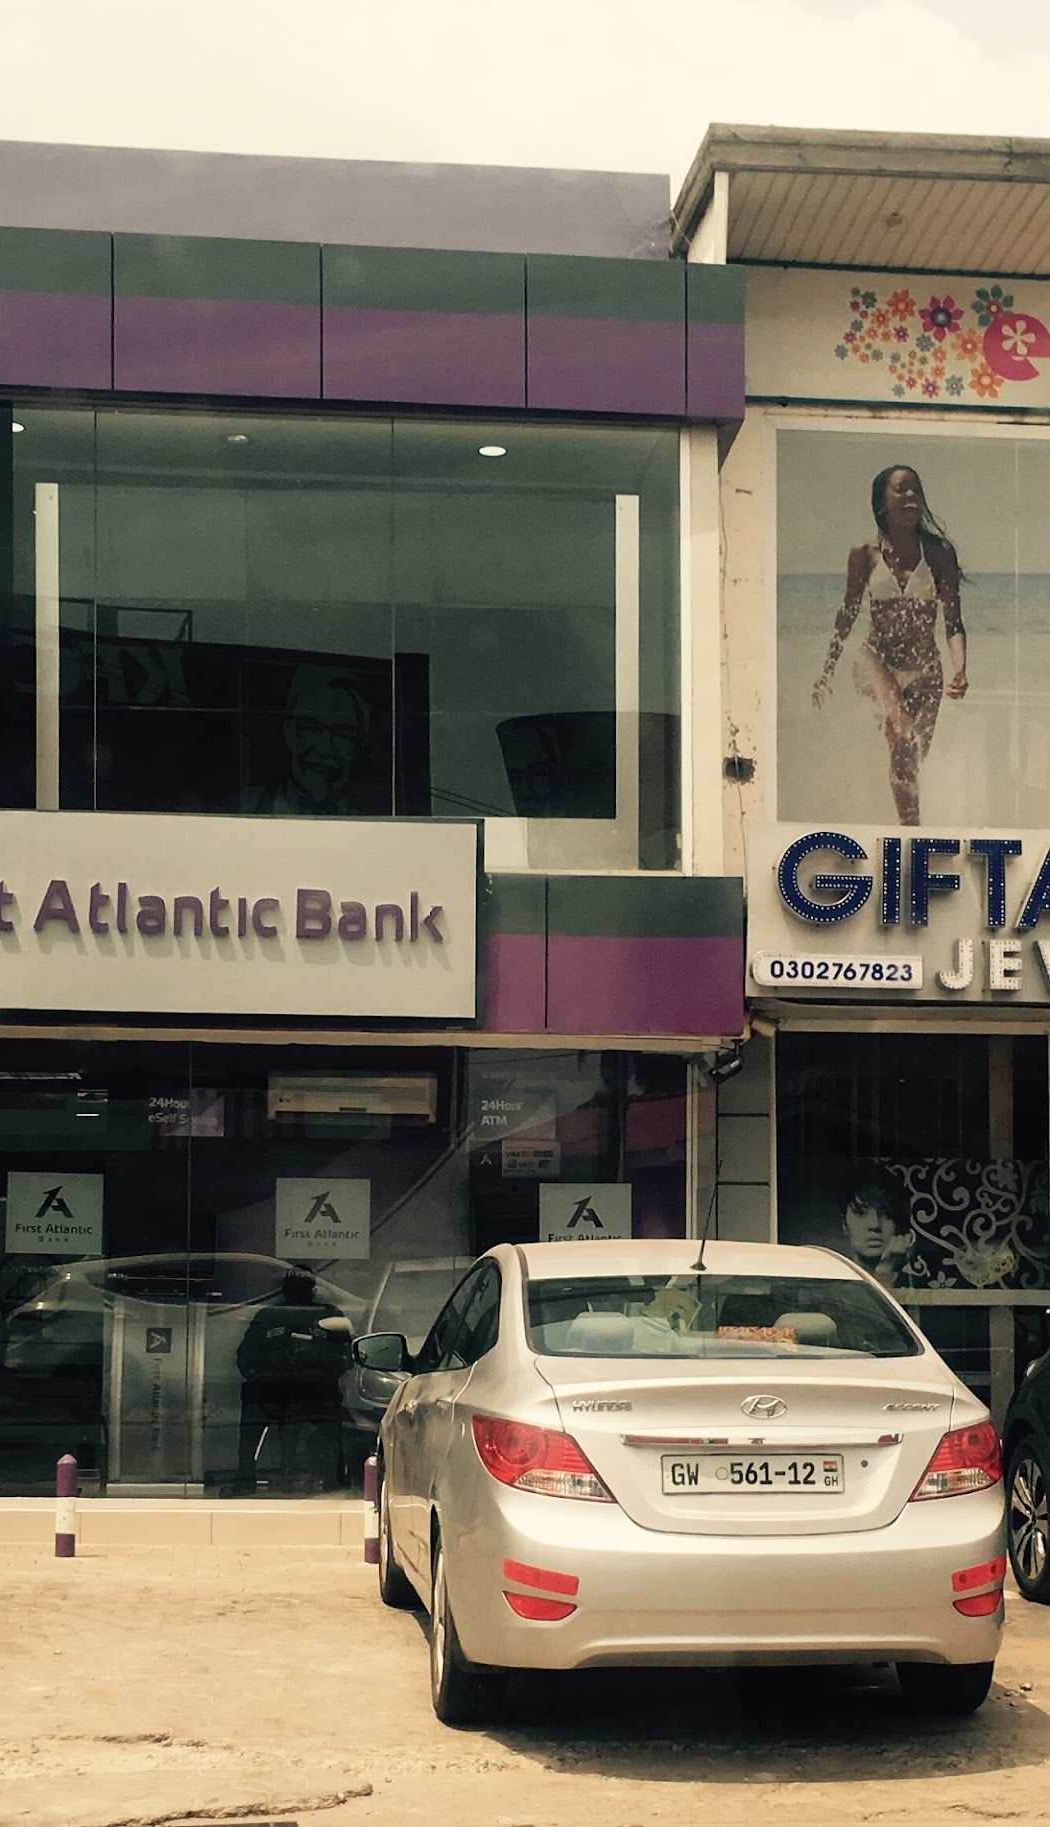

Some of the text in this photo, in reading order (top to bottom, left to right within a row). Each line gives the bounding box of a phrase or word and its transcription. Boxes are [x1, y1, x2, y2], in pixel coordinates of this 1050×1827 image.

[33, 878, 281, 938] Atlantic
[295, 888, 446, 943] Bank
[770, 959, 913, 982] 0302767823
[480, 1115, 508, 1125] ATM
[15, 1223, 93, 1235] First Atlantic
[284, 1228, 360, 1240] First Atlantic
[572, 1399, 632, 1412] HYUNDAI
[881, 1402, 941, 1412] ACCENT
[671, 1462, 816, 1486] GW 561-12
[824, 1475, 839, 1487] GH
